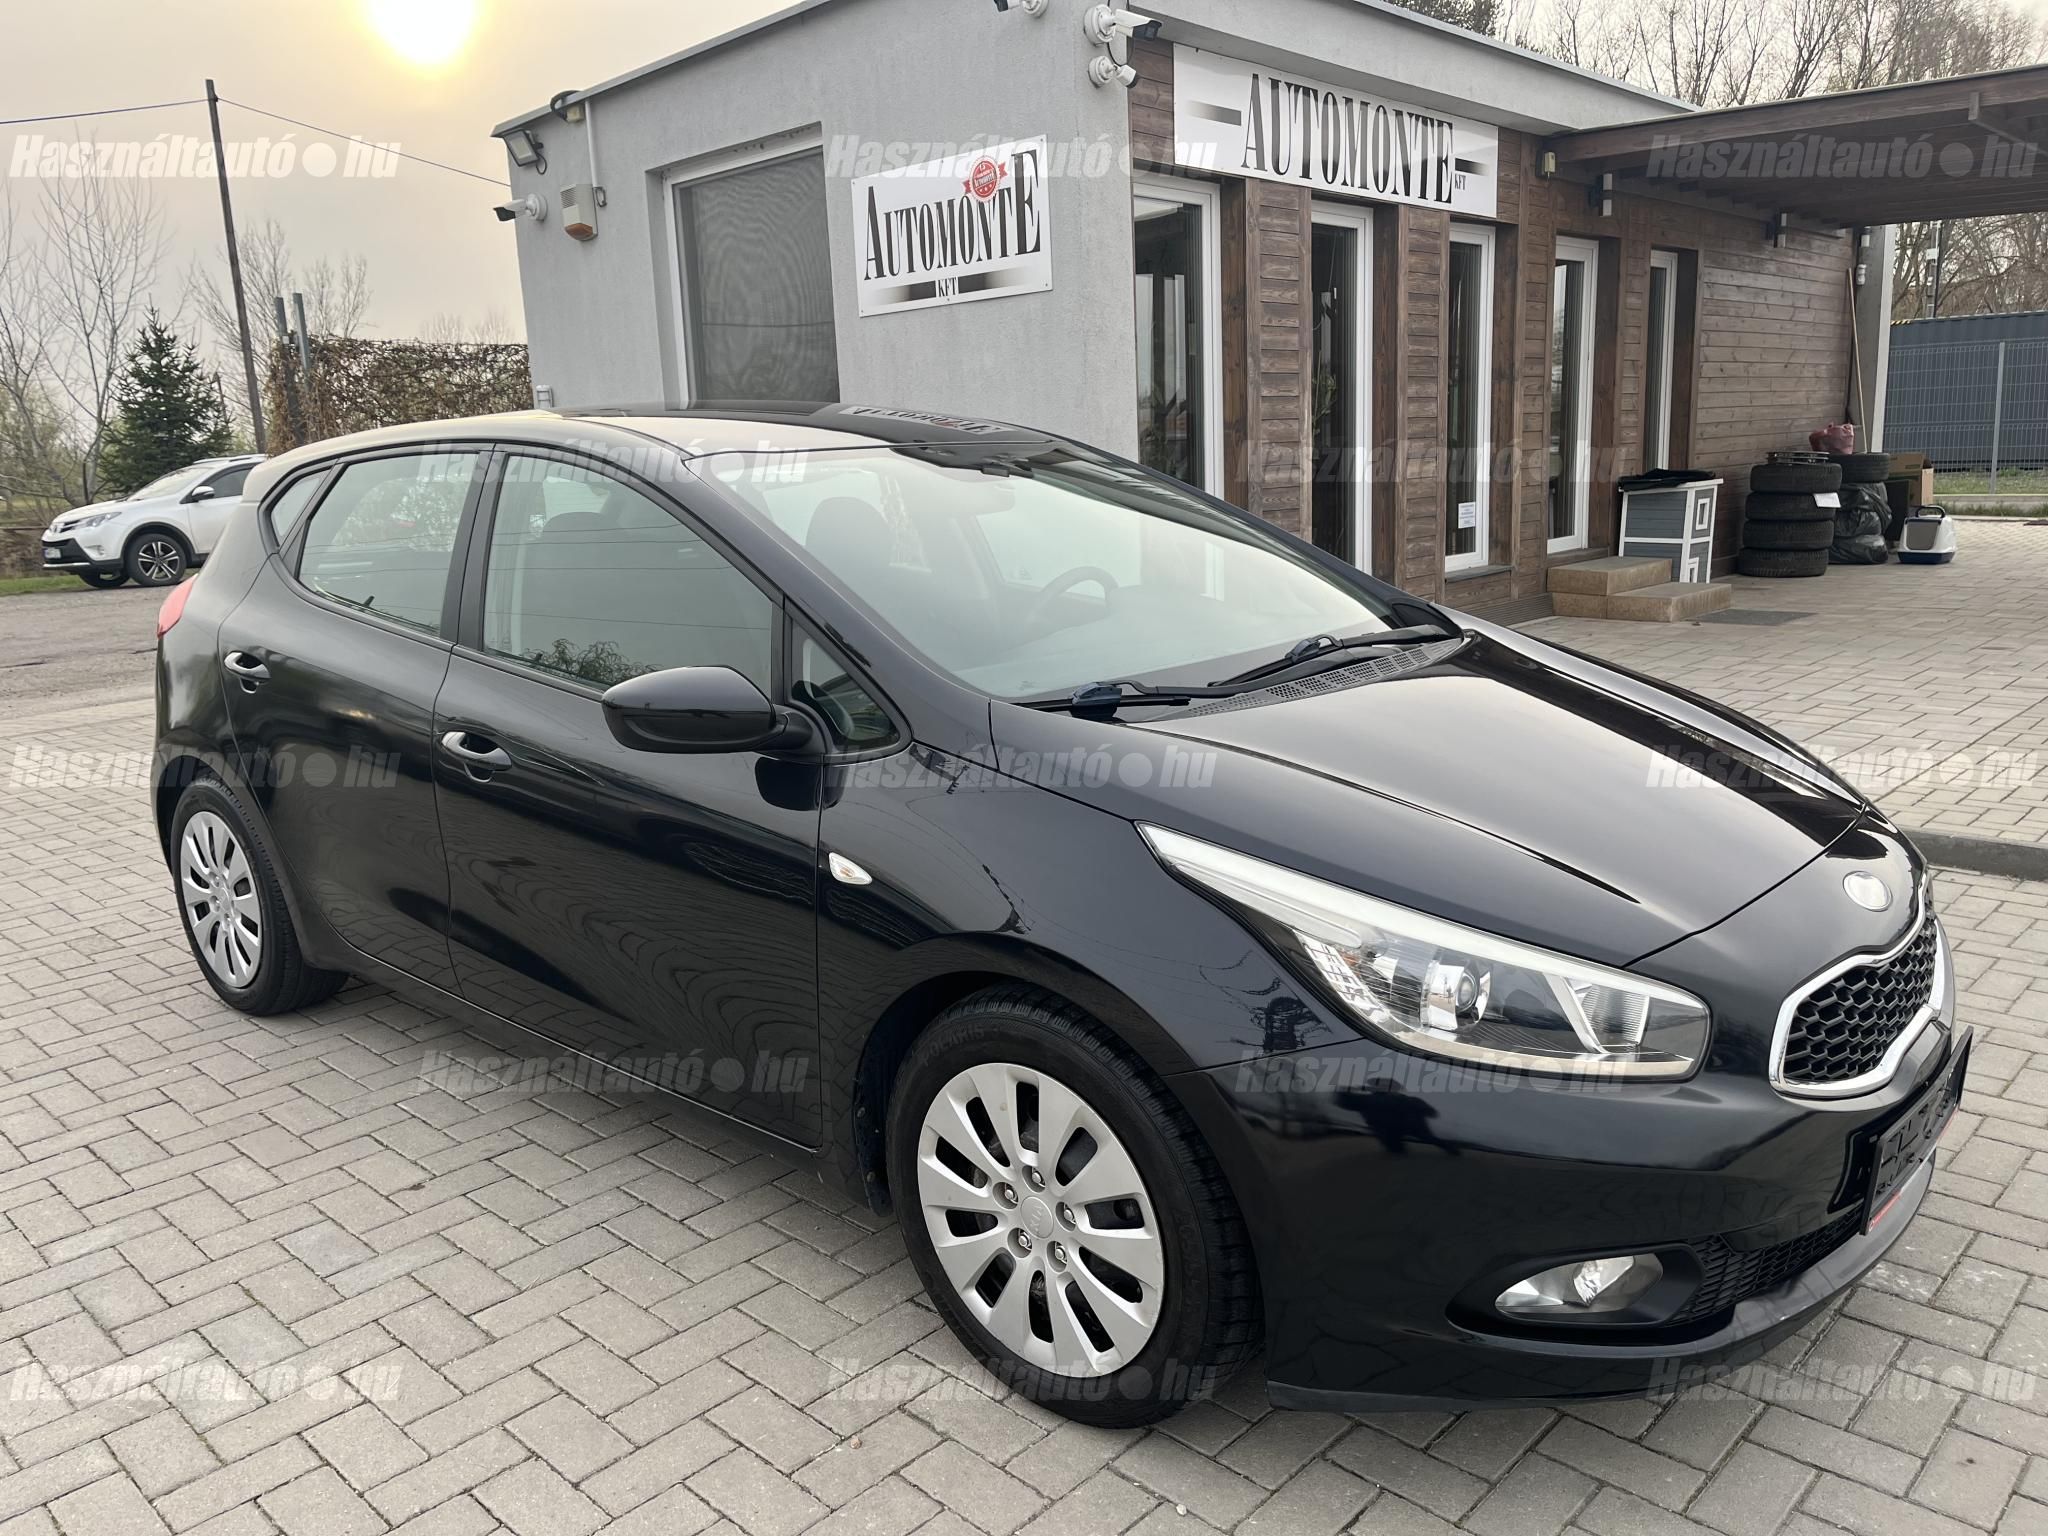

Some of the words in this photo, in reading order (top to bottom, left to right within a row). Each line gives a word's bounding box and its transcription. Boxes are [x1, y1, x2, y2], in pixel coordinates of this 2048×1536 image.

[1241, 73, 1454, 204] AUTOMONTE
[864, 150, 1041, 281] AUTOMONTE
[1454, 177, 1466, 191] KFT
[937, 277, 957, 297] KFT
